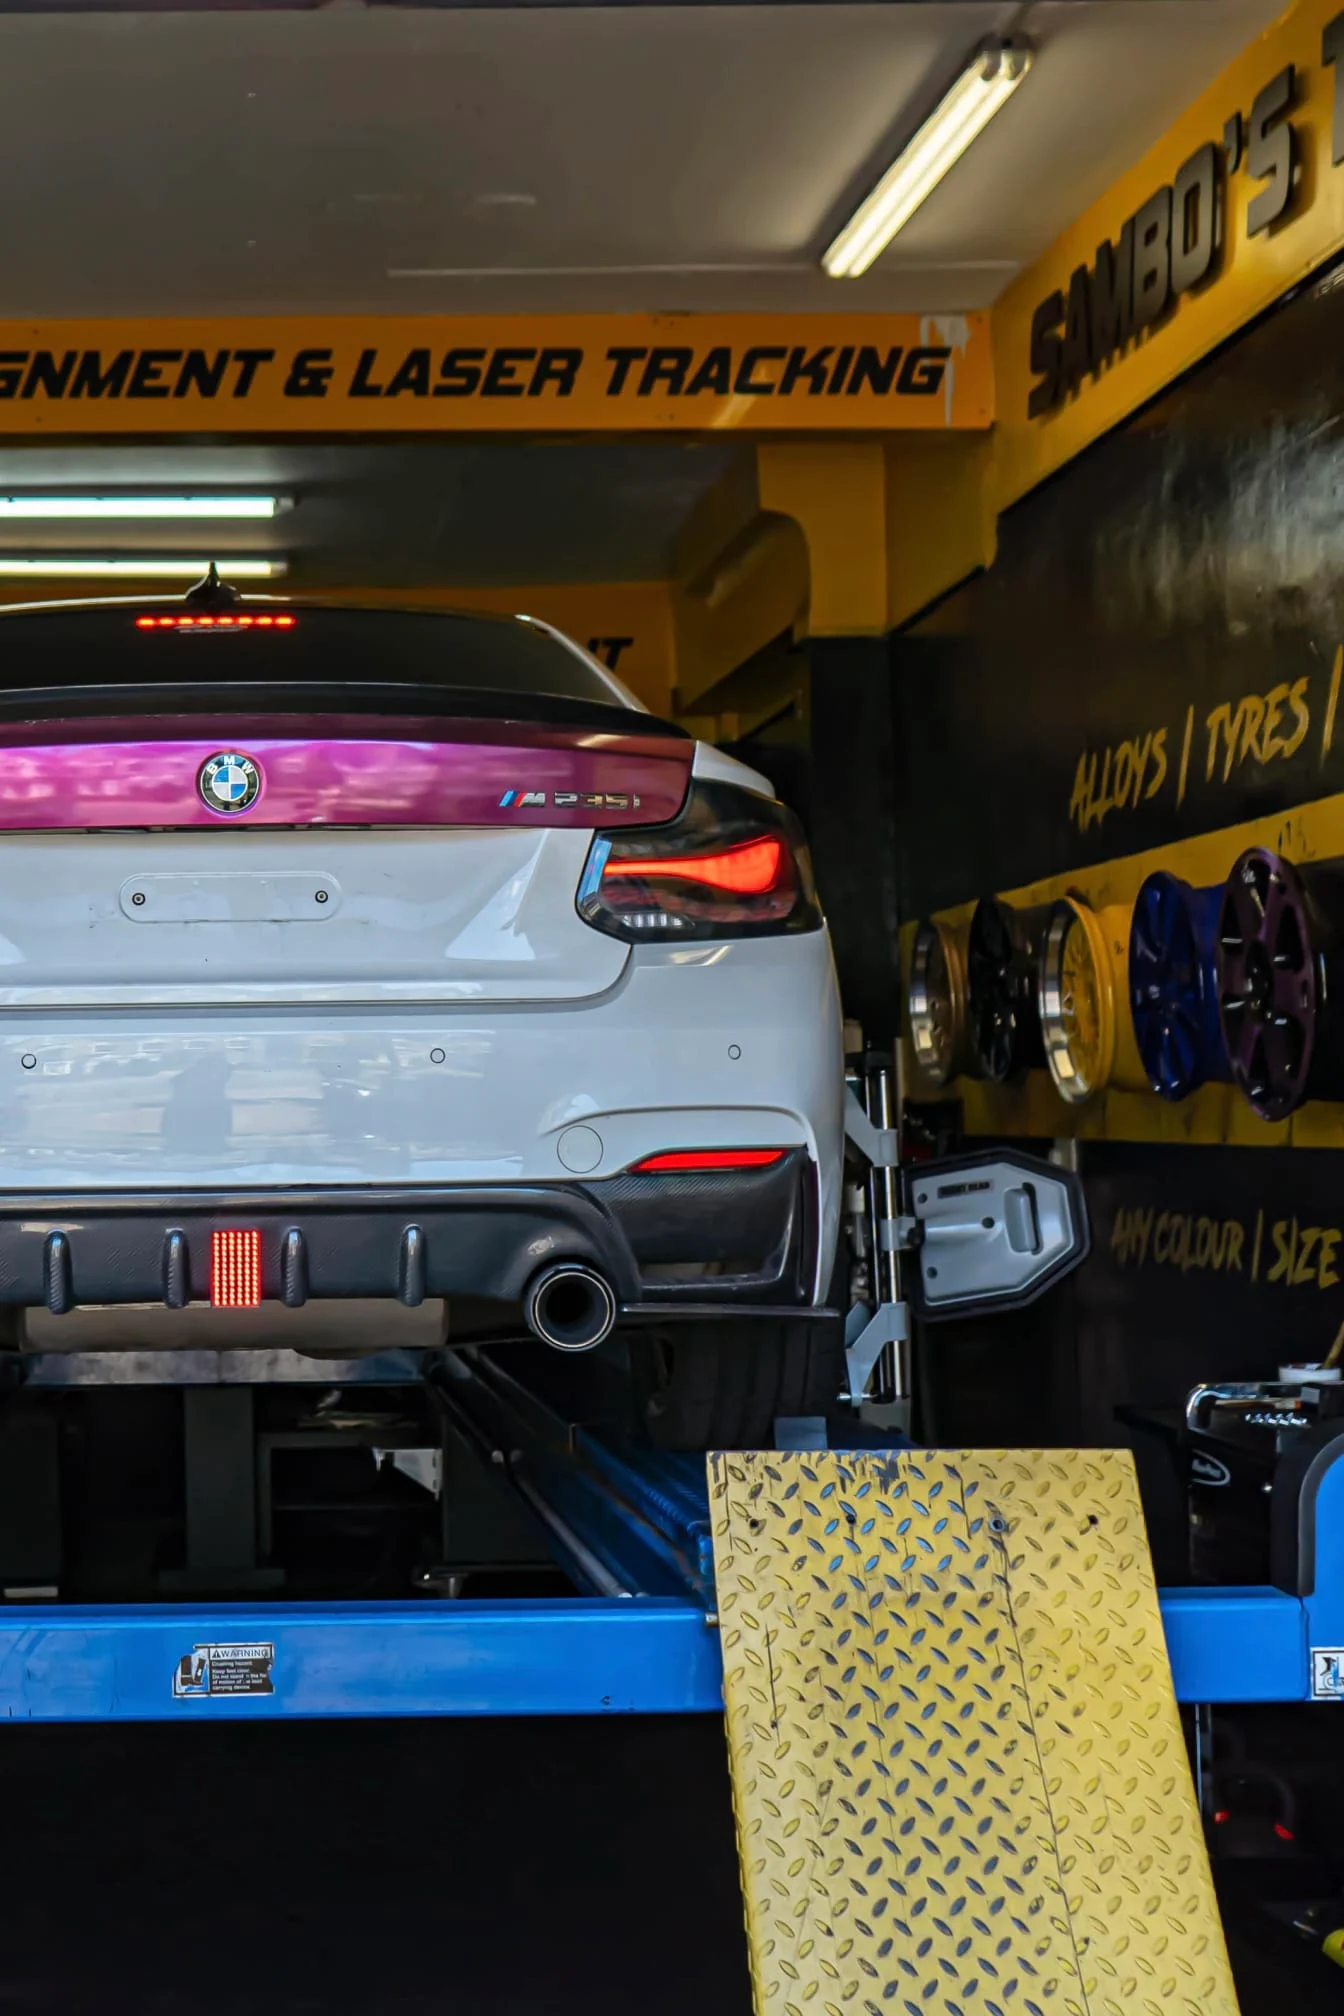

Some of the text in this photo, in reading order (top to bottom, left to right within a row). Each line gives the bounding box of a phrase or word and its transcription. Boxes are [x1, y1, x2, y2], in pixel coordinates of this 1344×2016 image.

[1028, 63, 1296, 420] SAMBO'S
[283, 349, 334, 398] &
[348, 347, 583, 398] LASER
[605, 346, 952, 396] TRACKING
[1069, 726, 1168, 834] ALLOYS
[1206, 675, 1310, 784] TYRES
[1153, 1211, 1245, 1275] COLOUR
[1267, 1214, 1343, 1290] SIZE
[221, 1648, 269, 1658] WARNING
